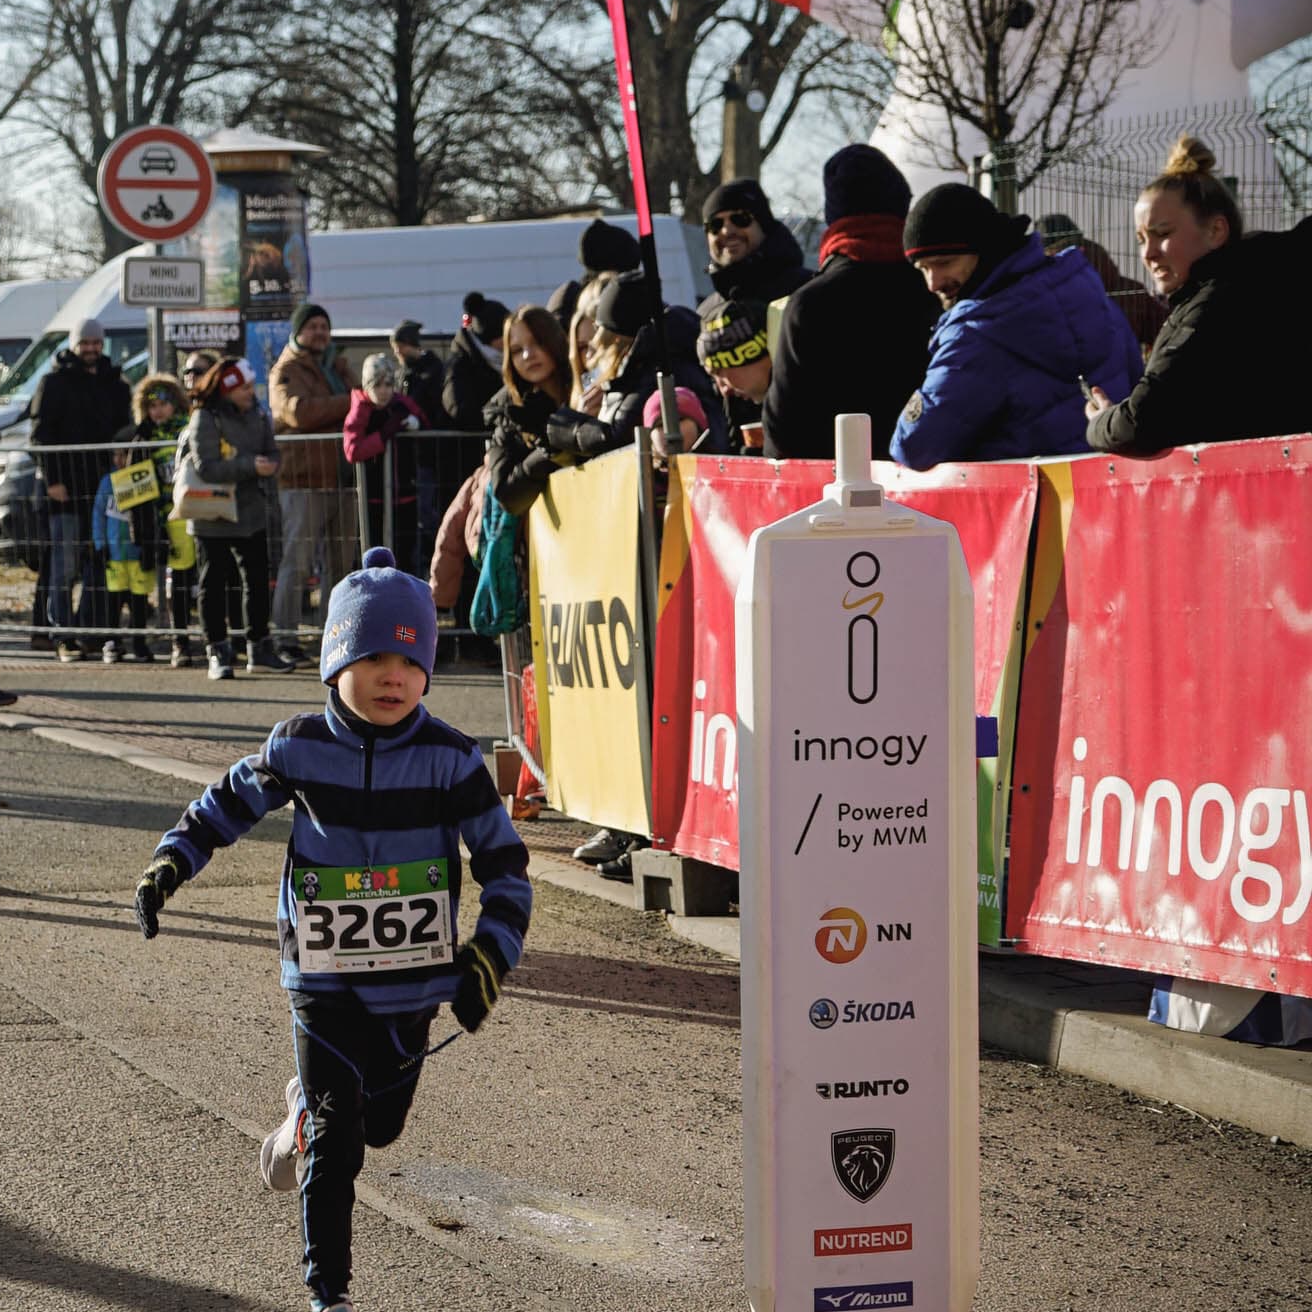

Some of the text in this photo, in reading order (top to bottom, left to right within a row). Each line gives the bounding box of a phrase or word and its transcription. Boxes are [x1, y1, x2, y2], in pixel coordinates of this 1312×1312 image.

[550, 596, 635, 690] RUNTO
[793, 729, 928, 767] innogy
[837, 798, 929, 822] Powered
[837, 825, 928, 853] by MVM
[1065, 736, 1312, 926] innogy
[303, 898, 440, 951] 3262
[876, 922, 912, 942] NN
[841, 1000, 916, 1024] ŠKODA
[833, 1078, 910, 1099] RUNTO
[837, 1134, 889, 1145] PEUGEOT
[819, 1230, 908, 1251] NUTREND
